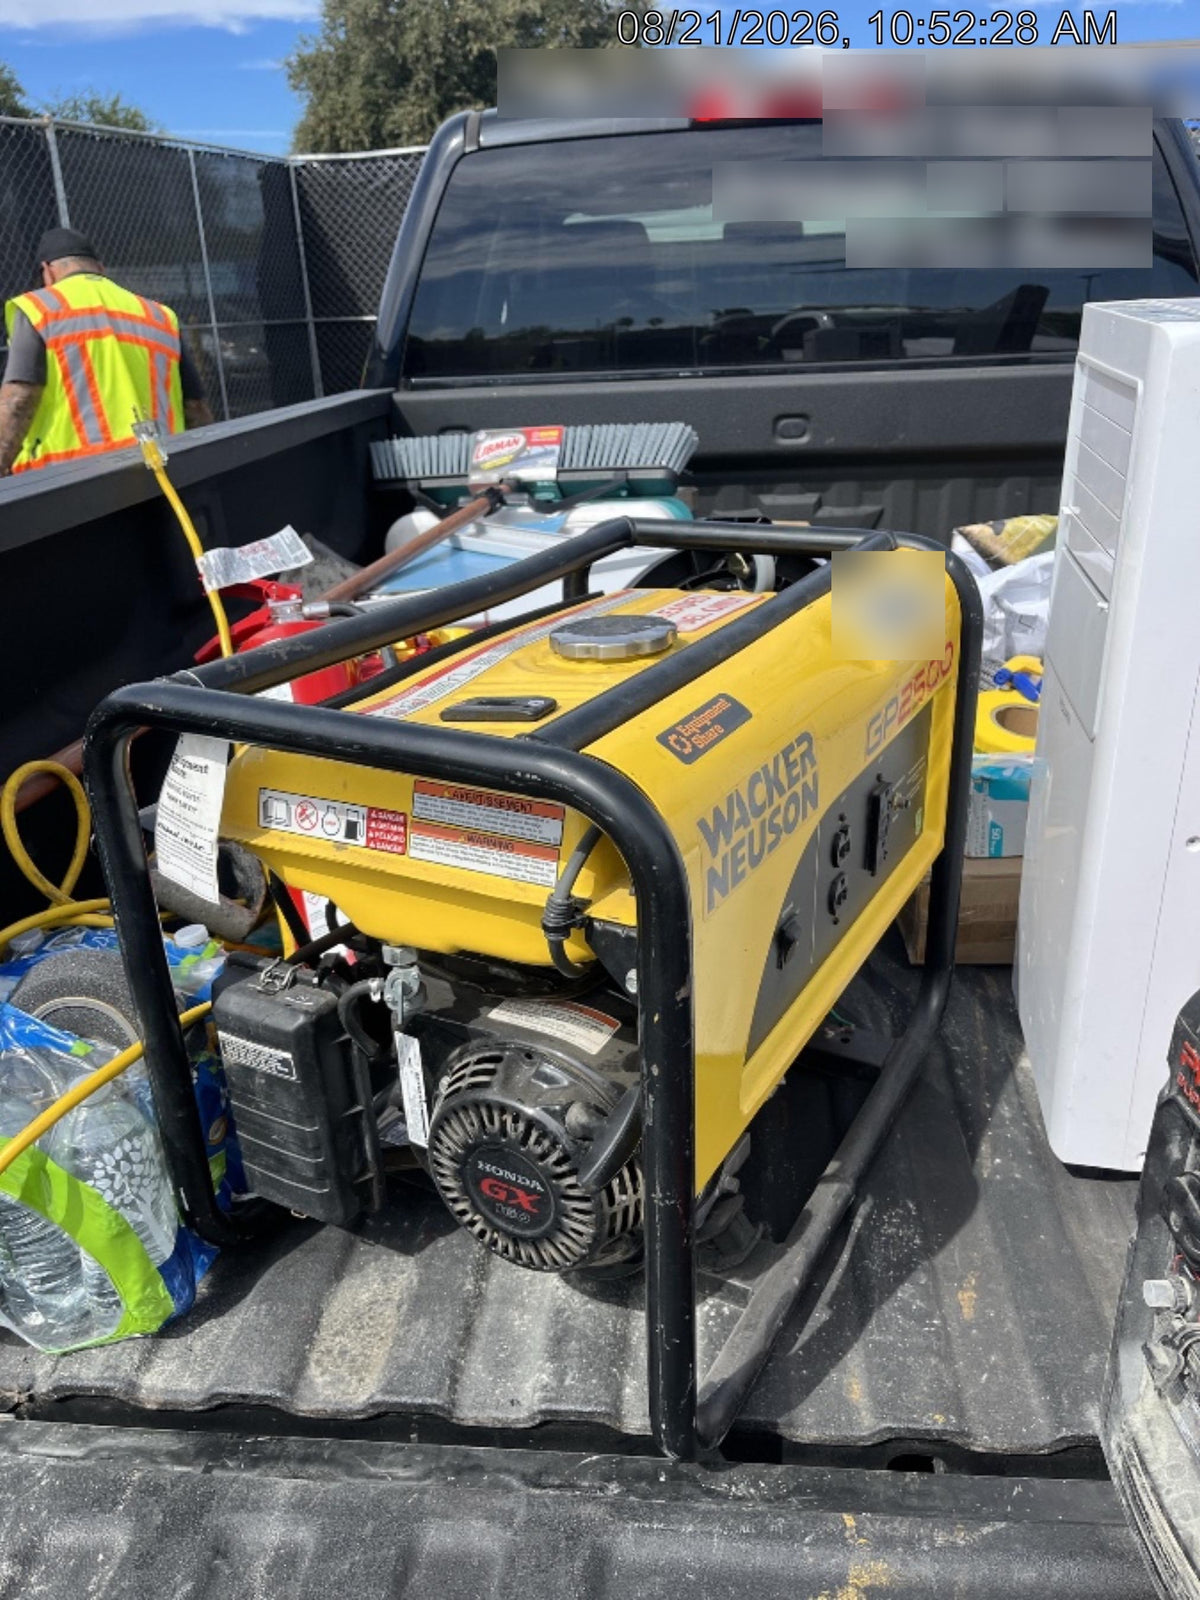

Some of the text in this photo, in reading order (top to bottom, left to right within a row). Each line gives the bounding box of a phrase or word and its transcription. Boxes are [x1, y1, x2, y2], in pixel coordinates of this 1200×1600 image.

[865, 640, 954, 757] GP2500
[675, 698, 732, 737] Equipment
[690, 724, 725, 750] Share
[696, 731, 817, 859] WACKER
[465, 832, 515, 852] WARNING
[706, 770, 819, 915] NEUSON
[477, 1160, 545, 1192] HONDA
[480, 1178, 542, 1214] GX
